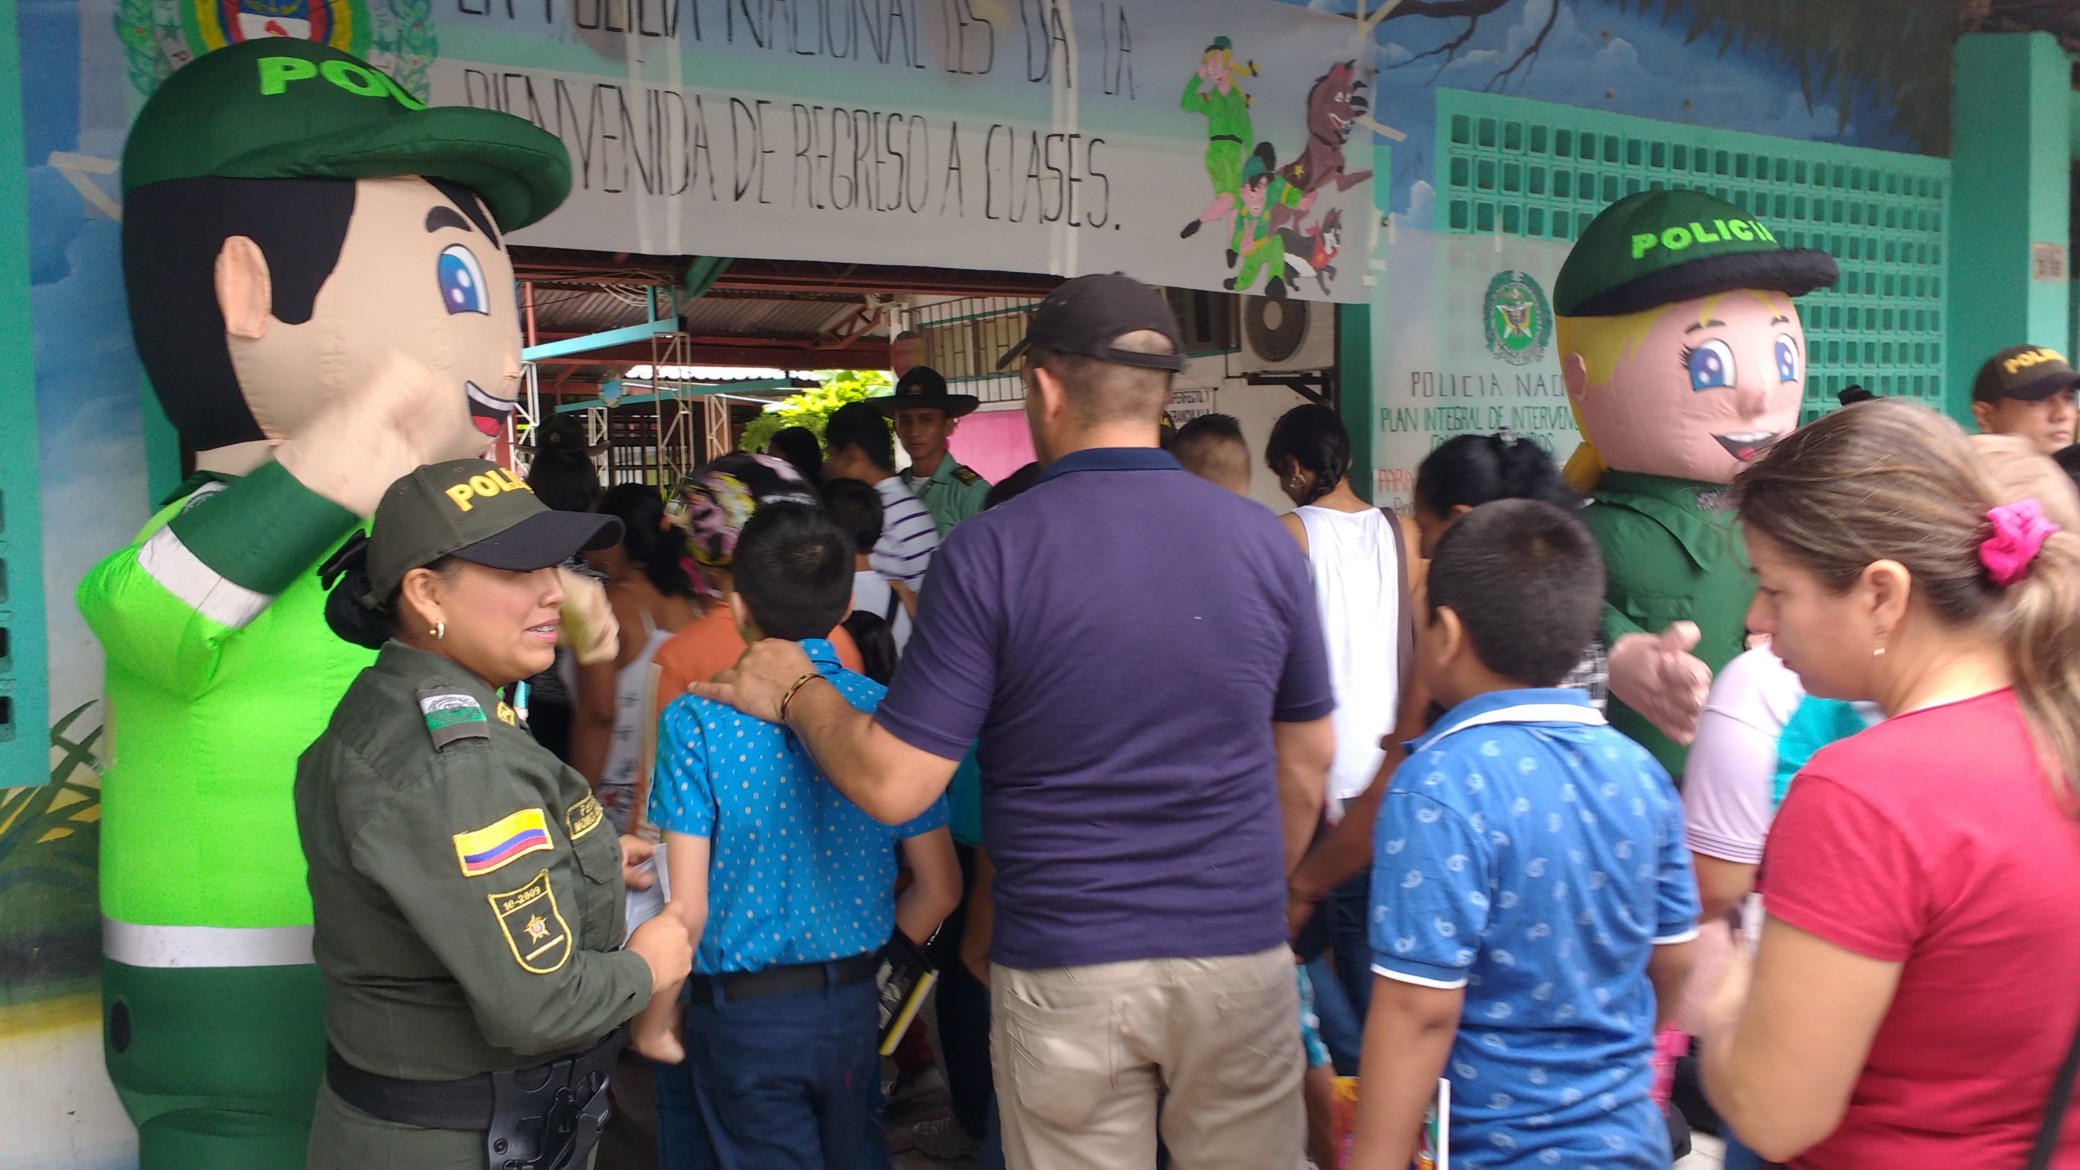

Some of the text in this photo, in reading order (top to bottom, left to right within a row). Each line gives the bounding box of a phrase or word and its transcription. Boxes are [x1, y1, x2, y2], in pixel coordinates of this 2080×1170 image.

[730, 97, 775, 203] DE
[791, 103, 929, 214] REGRESO
[940, 120, 964, 217] A
[984, 124, 1121, 230] CLASES.
[1411, 371, 1502, 397] POLICIA
[1380, 407, 1418, 432] PLAN
[1424, 406, 1482, 431] INTEGRAL
[1512, 406, 1579, 431] INTERVEN
